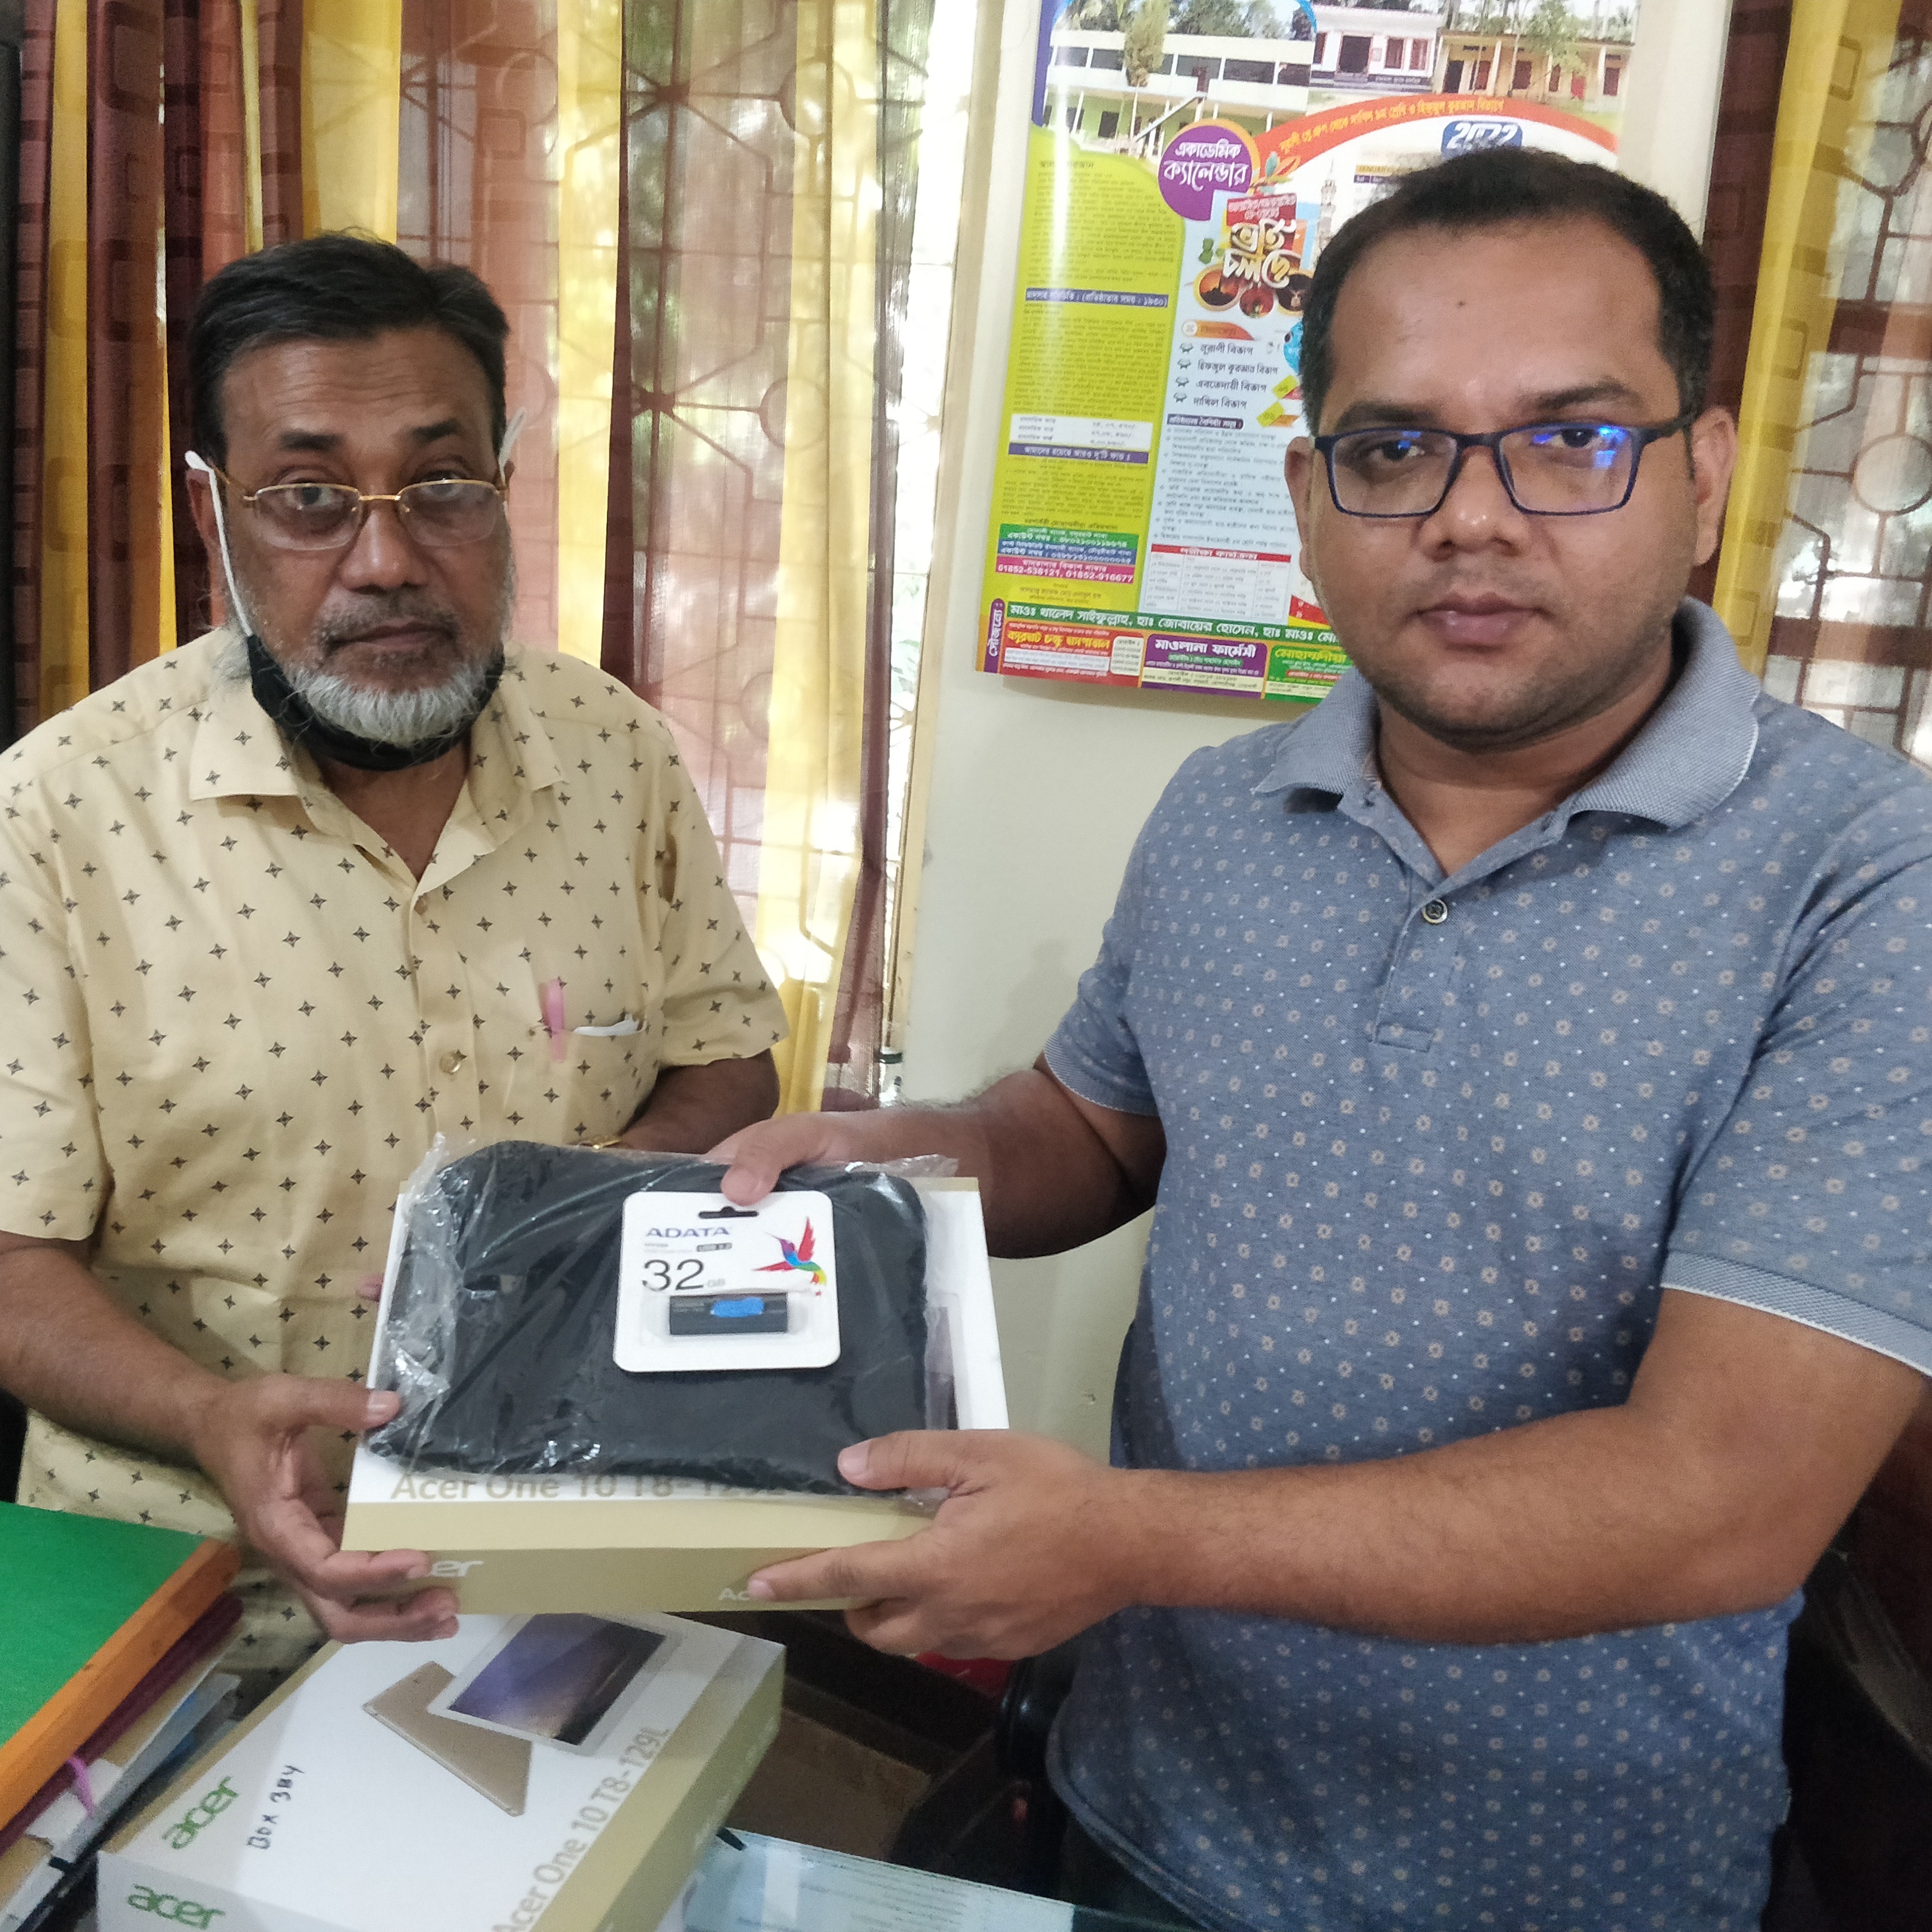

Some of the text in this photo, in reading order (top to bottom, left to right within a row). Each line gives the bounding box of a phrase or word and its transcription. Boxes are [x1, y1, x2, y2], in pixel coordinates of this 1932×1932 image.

[1175, 138, 1242, 159] একাডেমিক
[1163, 159, 1249, 191] ক্যালেন্ডার
[1223, 248, 1302, 290] চলছে
[1227, 342, 1253, 356] বিভাগ
[1198, 358, 1278, 375] হিফজুল কুরআন বিভাগ
[1240, 379, 1267, 392] বিভাগ
[1194, 395, 1247, 409] দাখিল বিভাগ
[1040, 607, 1074, 621] খালেদ
[1158, 617, 1214, 633] জোবায়ের
[1216, 622, 1258, 638] হোসেন,
[1154, 638, 1257, 659] মাওলানা ফার্মেসী
[646, 1227, 730, 1238] ADATA
[642, 1258, 705, 1291] 32
[390, 1473, 477, 1500] Acer
[485, 1472, 560, 1499] One
[162, 1776, 240, 1850] acer
[532, 1838, 589, 1884] One
[570, 1806, 610, 1832] 10
[590, 1726, 670, 1801] T8-129L
[127, 1883, 226, 1930] acer
